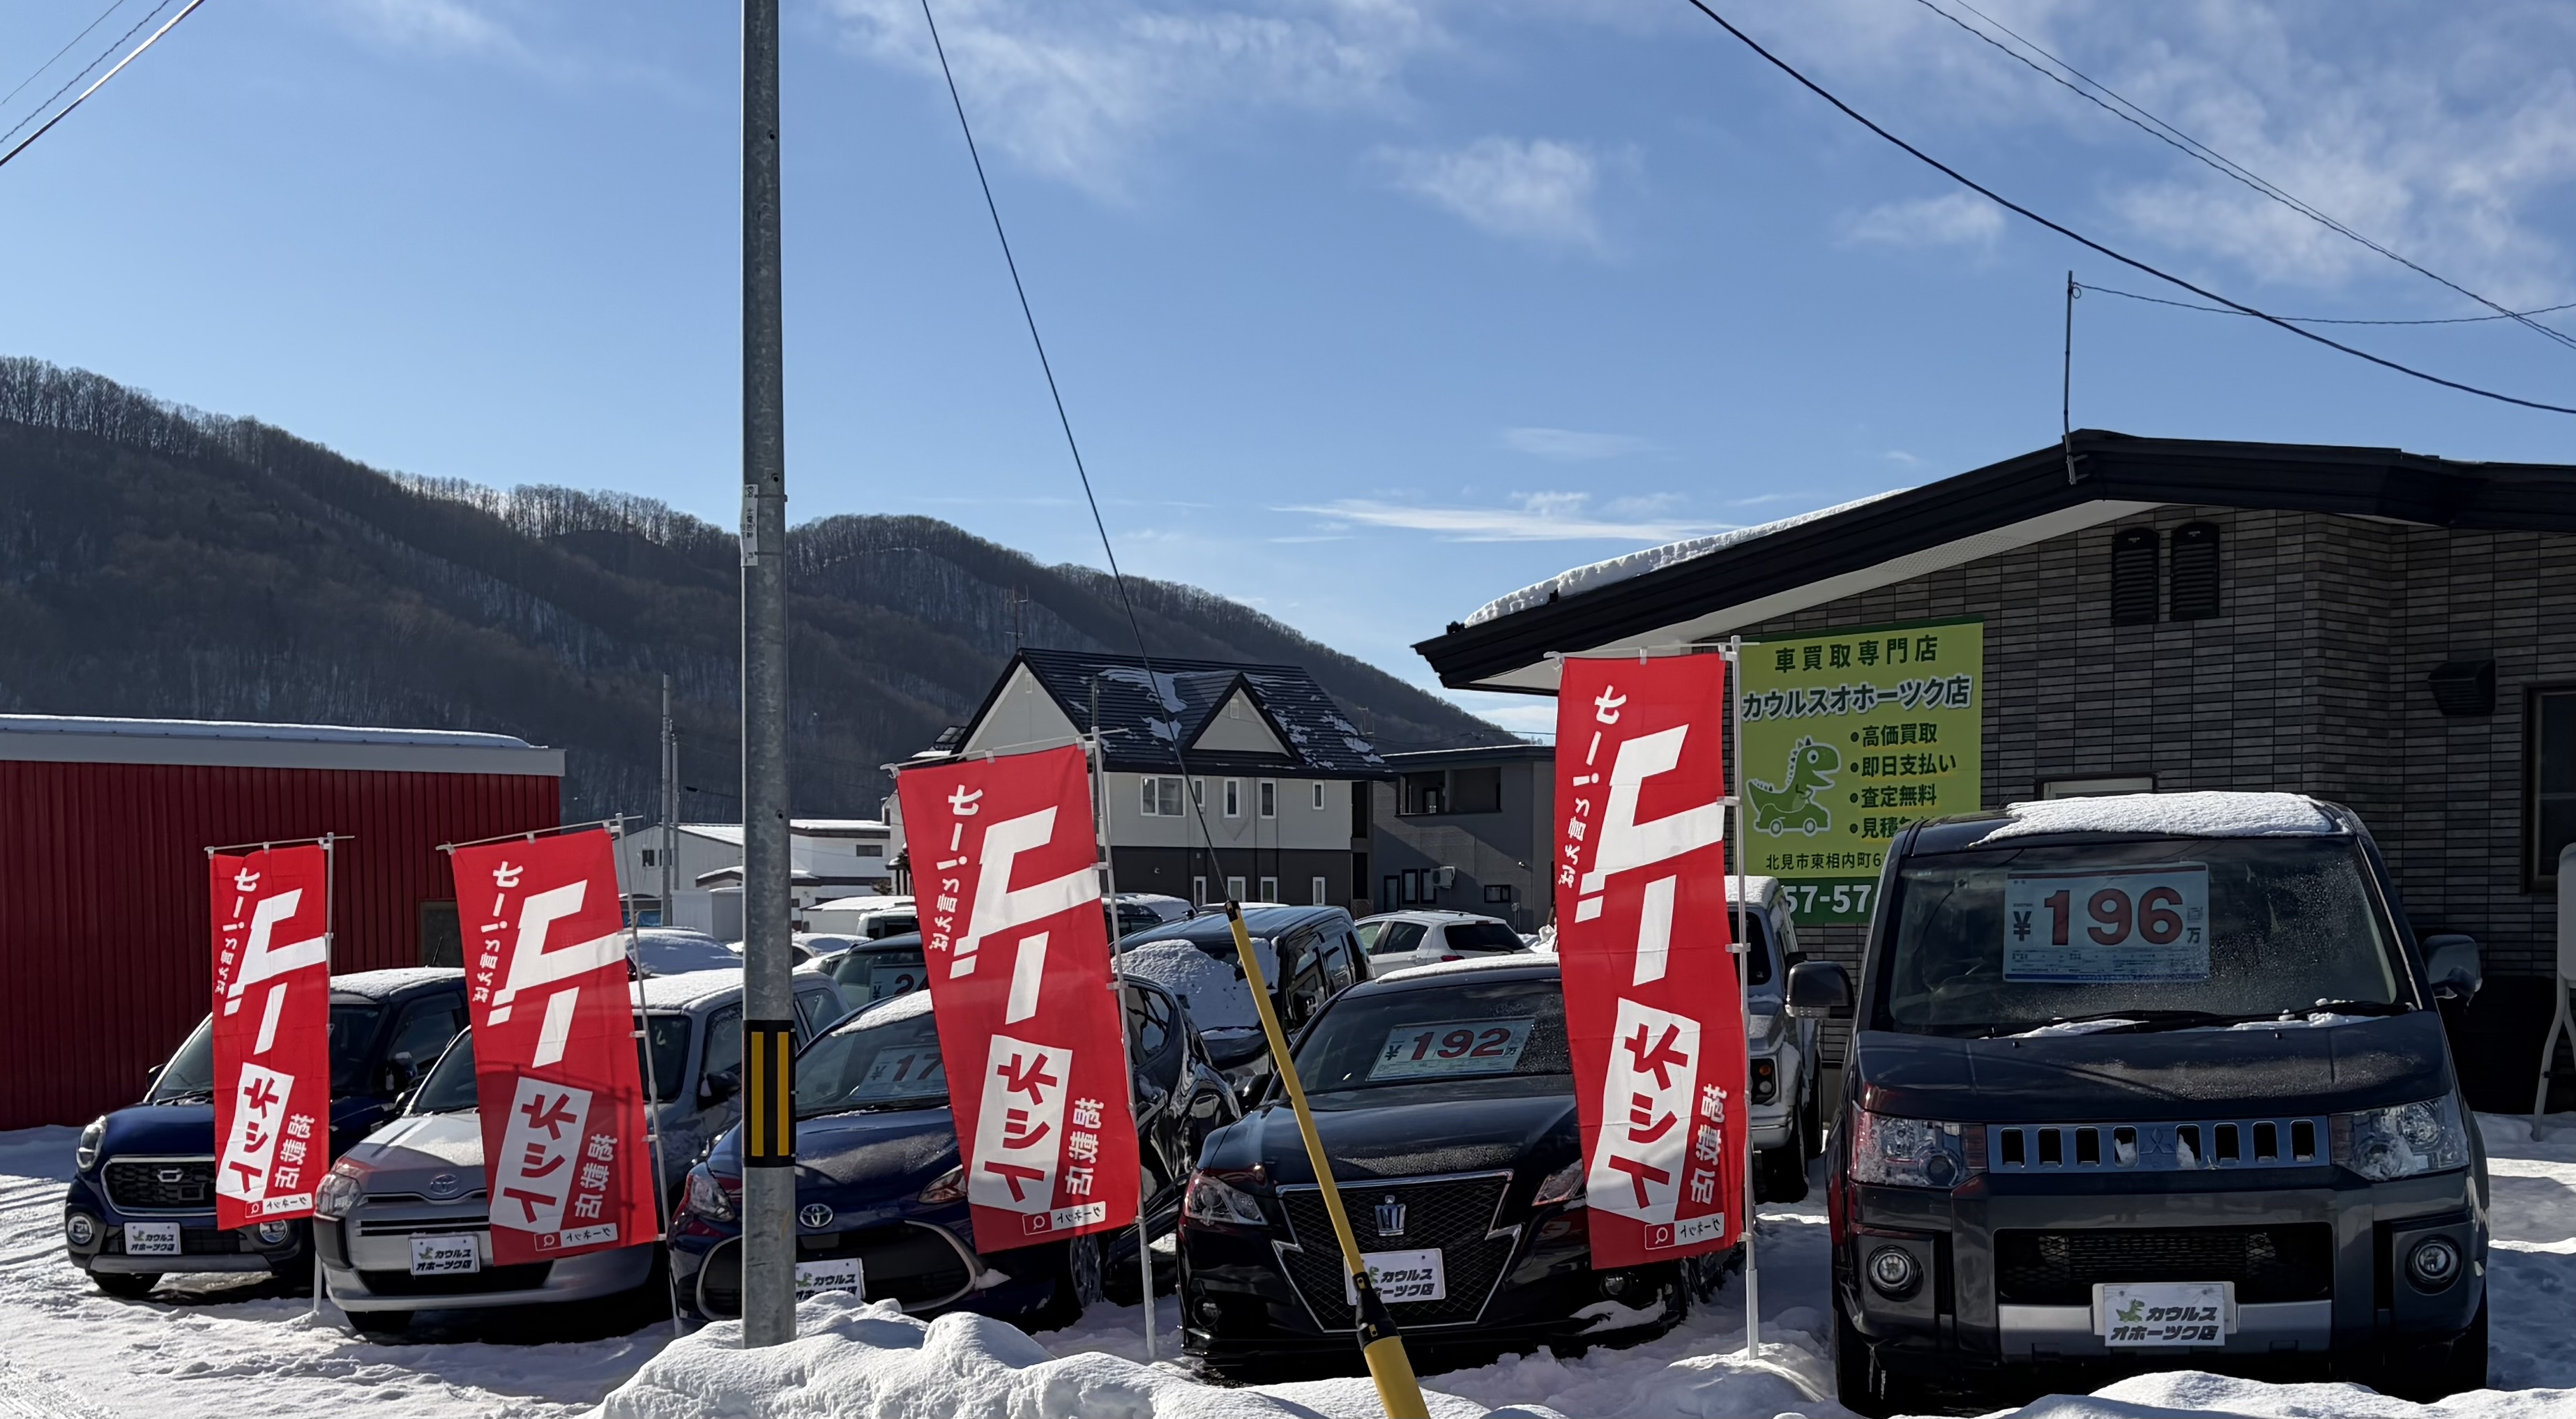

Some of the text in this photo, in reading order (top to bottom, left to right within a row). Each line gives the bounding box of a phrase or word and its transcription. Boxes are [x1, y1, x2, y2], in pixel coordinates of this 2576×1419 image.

[1775, 635, 1938, 673] 車買取専門店
[1743, 675, 1971, 720] カウルスオホーツク店
[1861, 723, 1937, 748] 高価買取
[1861, 753, 1957, 777] 即日支払い
[1861, 784, 1937, 808] 査定無料
[1766, 852, 1884, 871] 北見市東相内町6
[434, 1249, 471, 1259] カウルス
[813, 1274, 856, 1286] カウルス
[1381, 1268, 1433, 1283] カウルス
[2146, 1307, 2218, 1321] カウルス
[2110, 1326, 2219, 1341] オホーツク店
